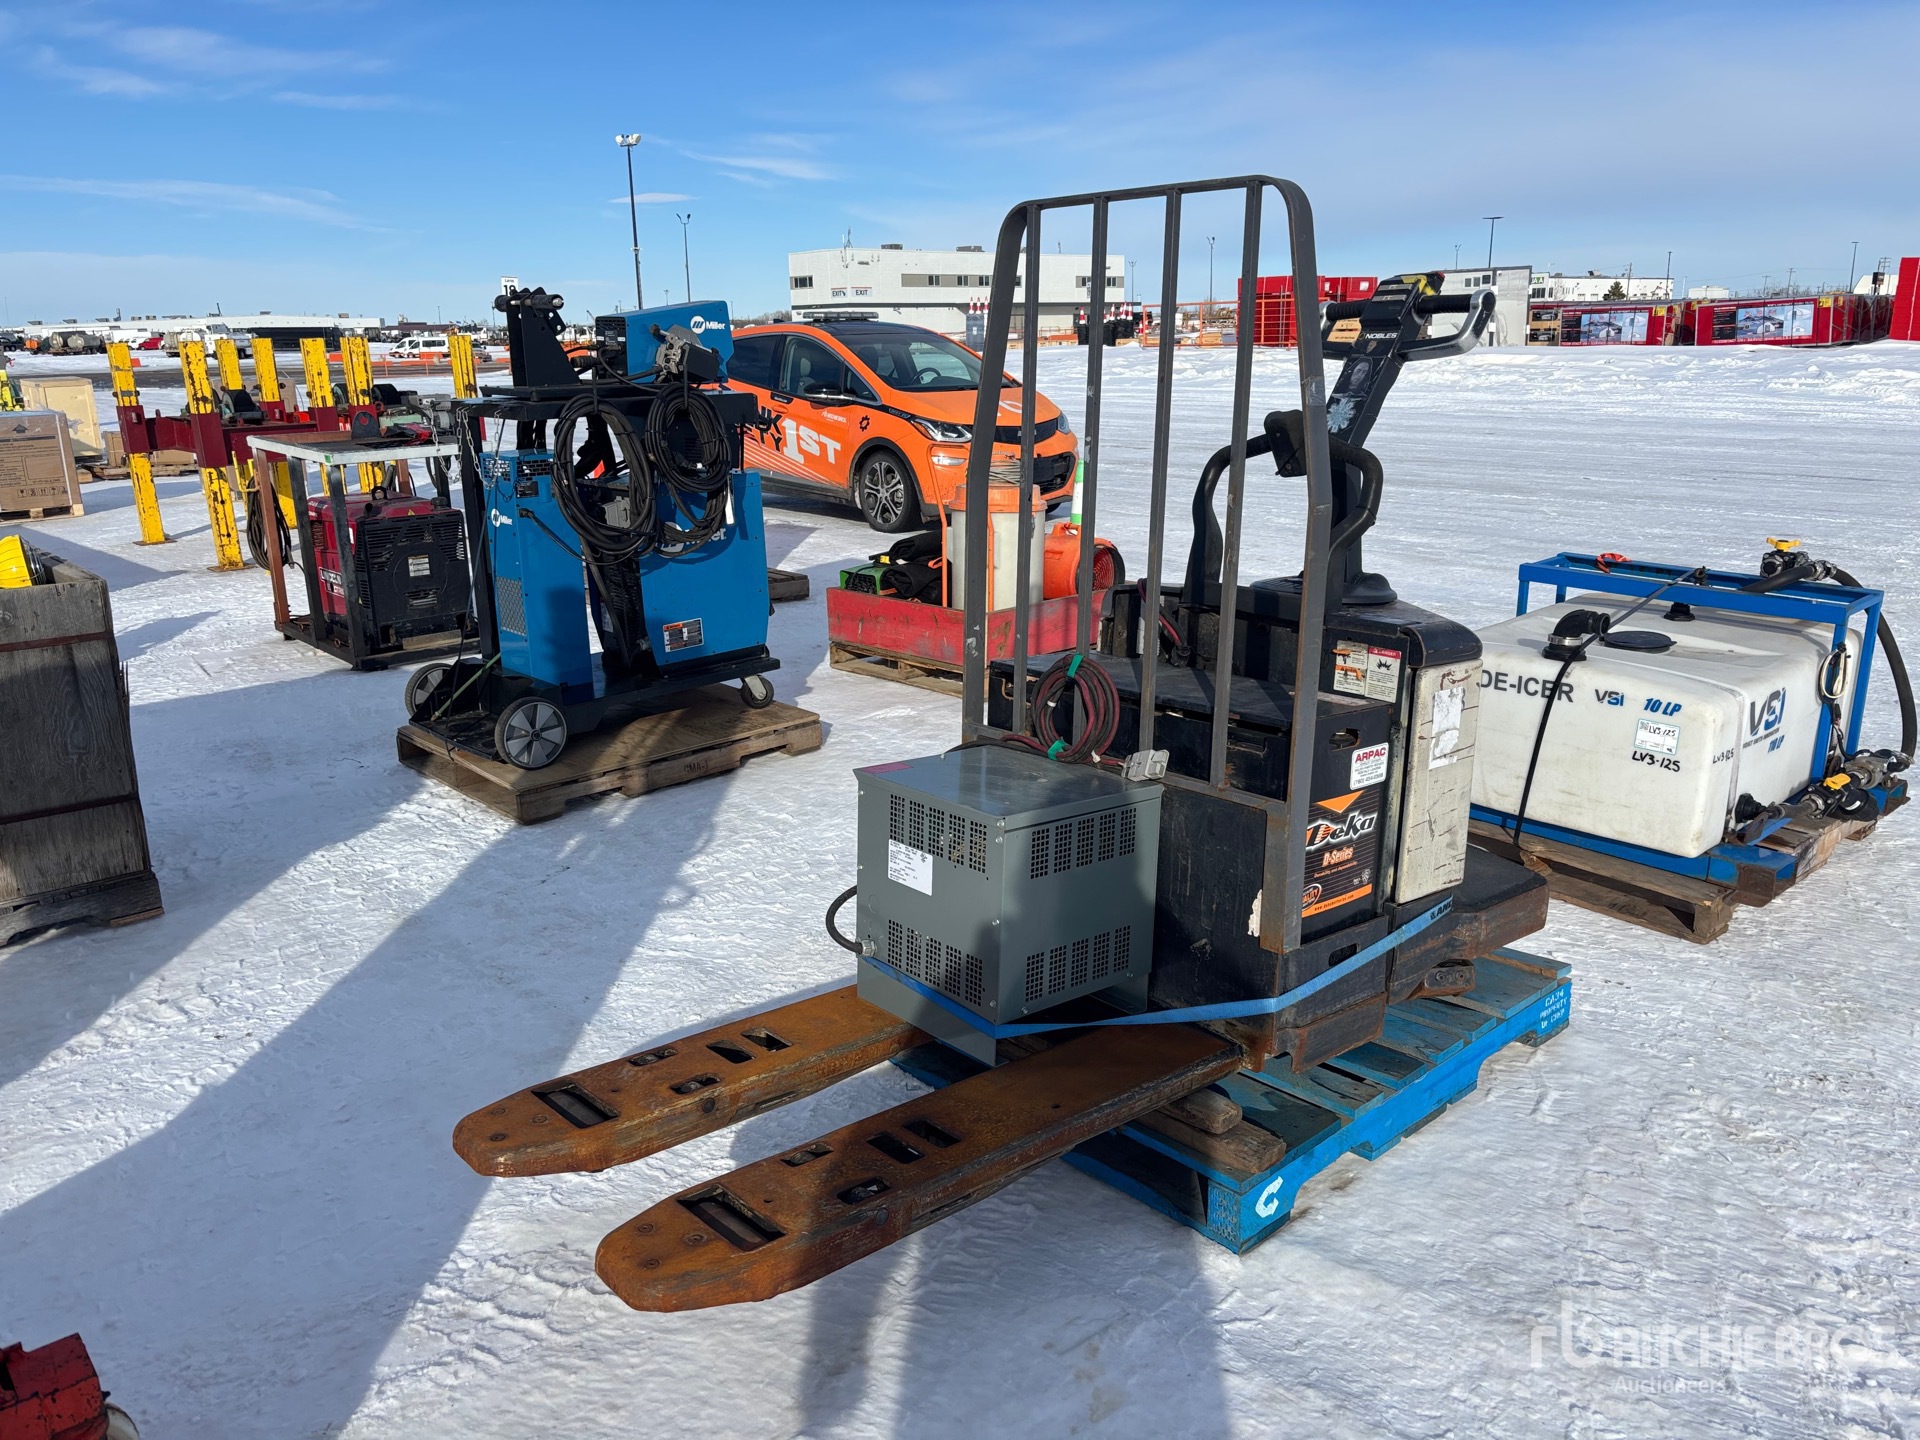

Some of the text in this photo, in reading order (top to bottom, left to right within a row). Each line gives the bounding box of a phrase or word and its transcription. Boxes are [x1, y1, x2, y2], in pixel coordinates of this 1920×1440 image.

[705, 320, 726, 330] Miller
[1364, 332, 1398, 340] NOBLES
[781, 417, 842, 465] 1ST
[1480, 669, 1575, 703] DE-ICER
[1643, 697, 1682, 717] 10 LP
[1354, 746, 1387, 763] ARPAC
[1631, 750, 1681, 773] LV3-125
[1306, 812, 1377, 850] Deka
[1321, 846, 1355, 868] D-Series
